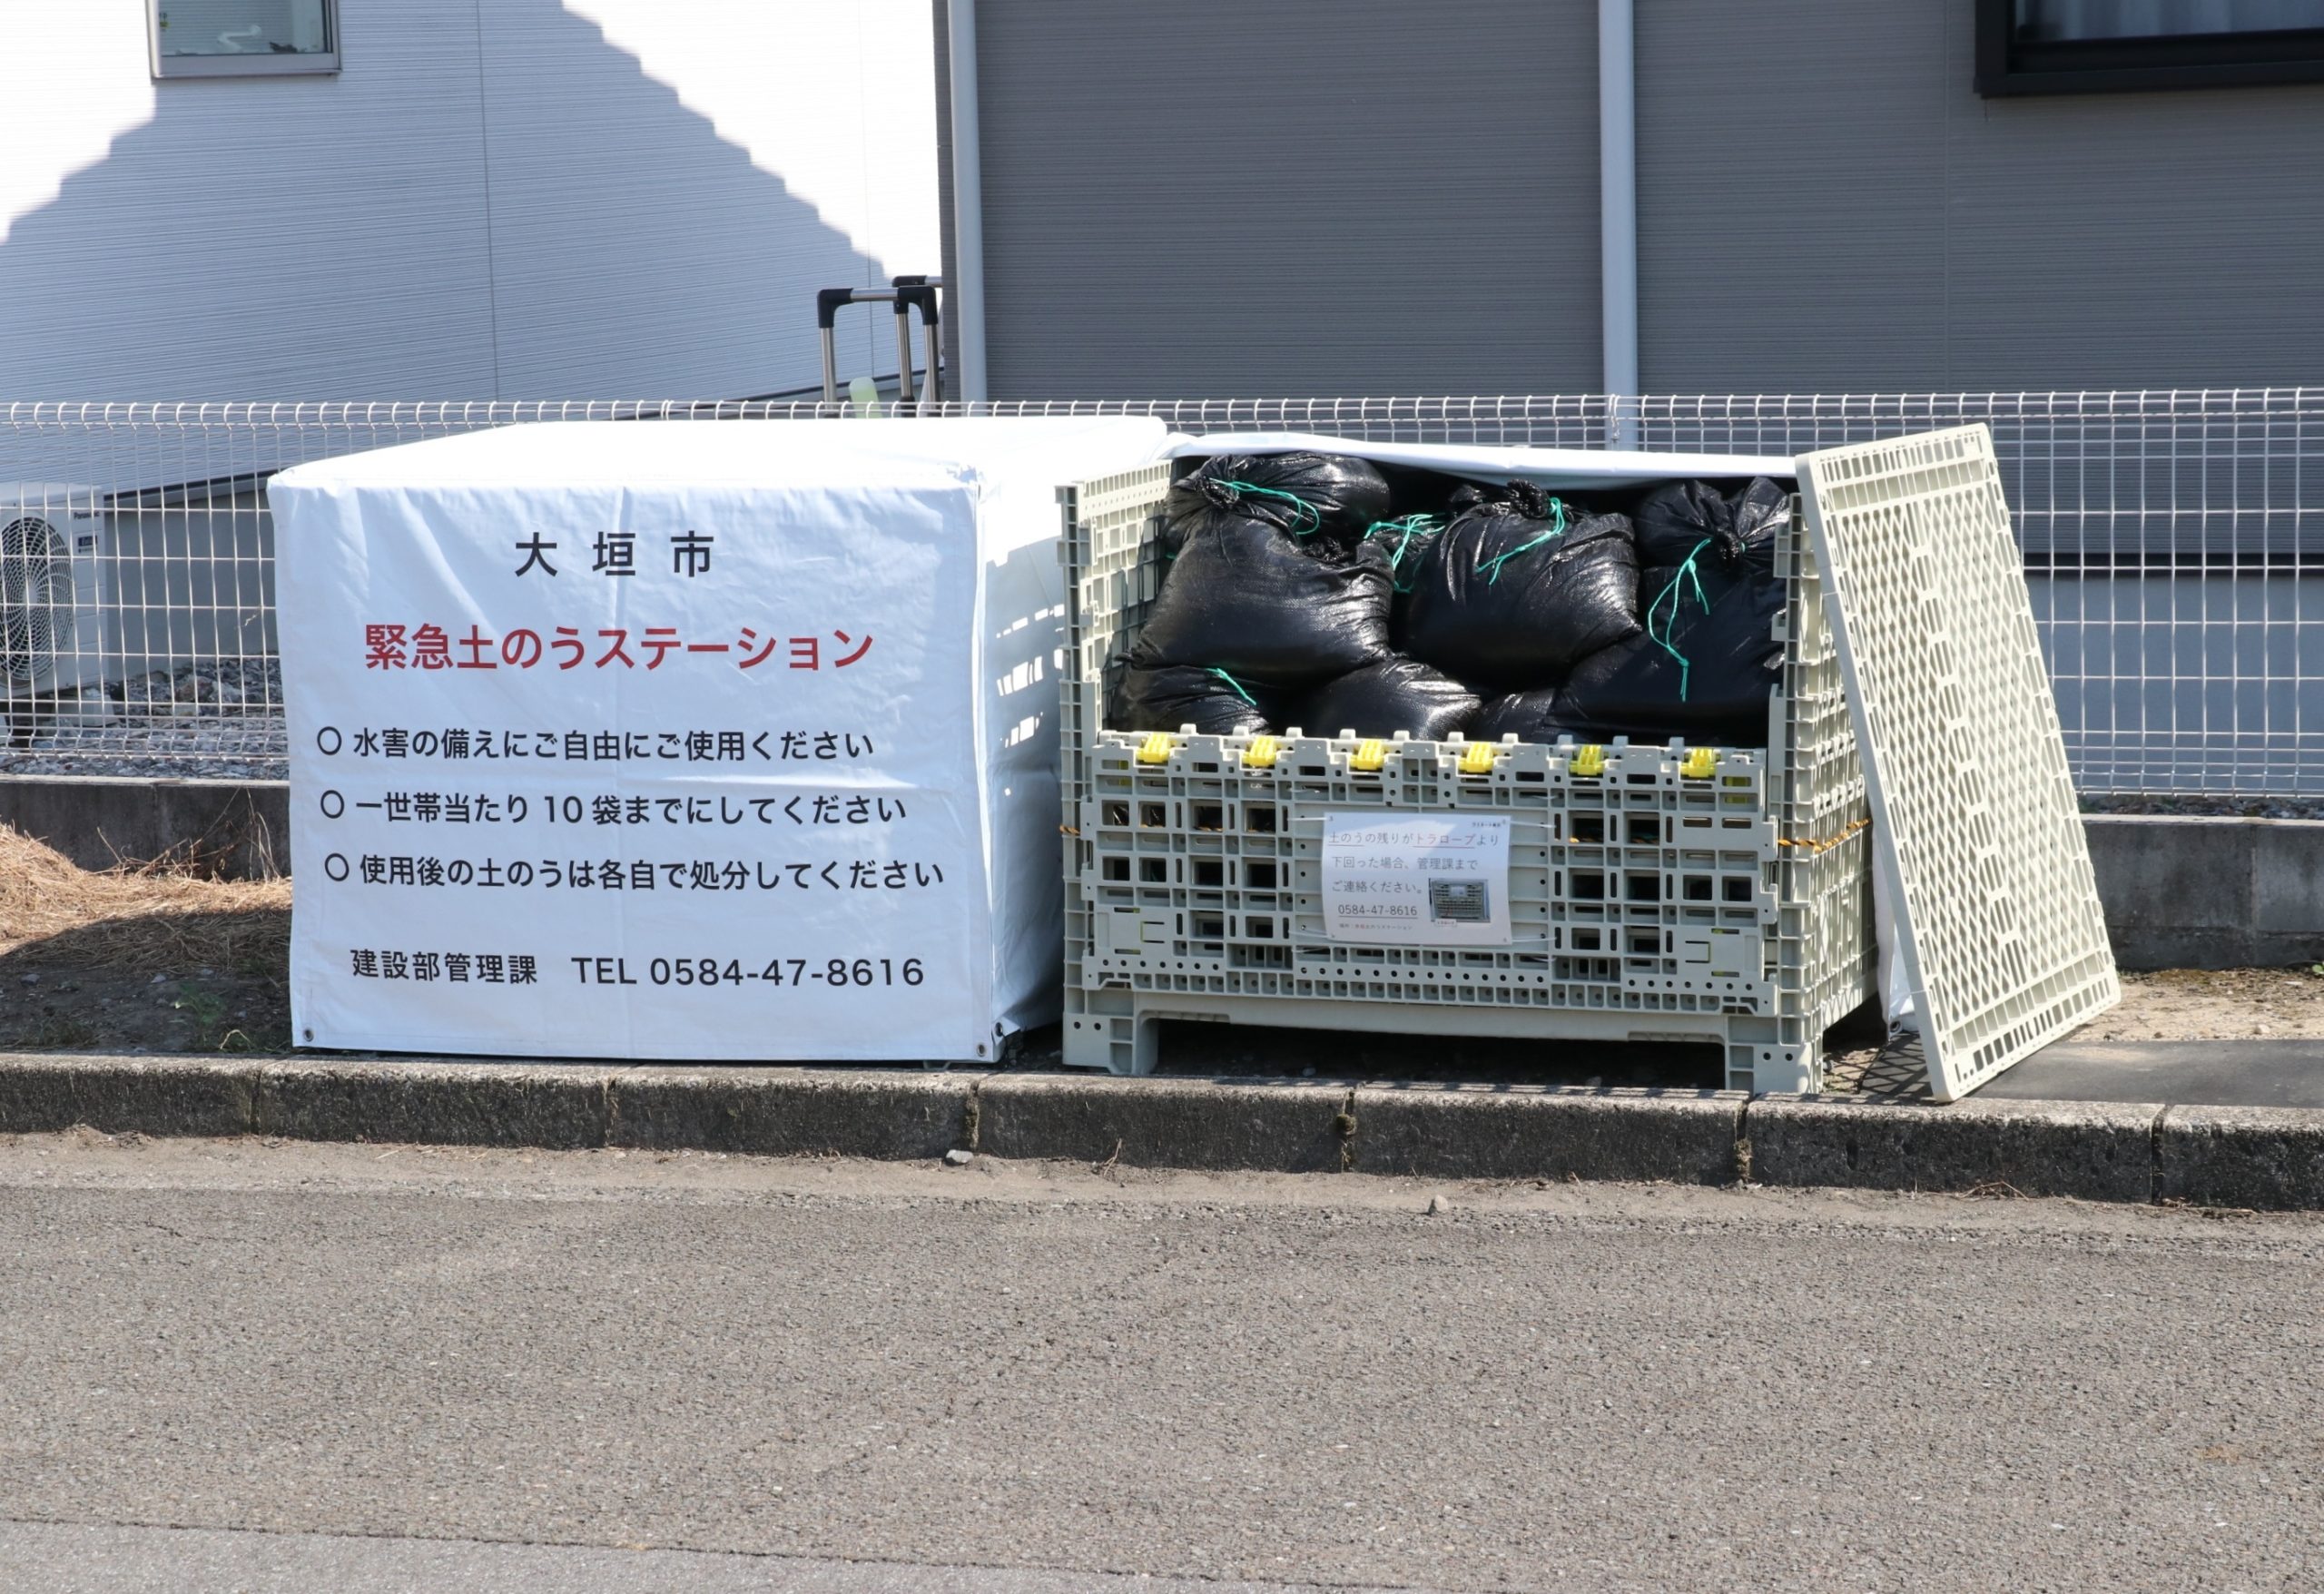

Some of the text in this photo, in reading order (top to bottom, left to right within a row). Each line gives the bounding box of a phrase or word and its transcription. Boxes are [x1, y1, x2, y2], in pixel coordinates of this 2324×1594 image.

[74, 511, 100, 520] Panasic
[514, 530, 714, 578] 大垣市
[365, 624, 874, 671] 緊急土のうステーション
[353, 726, 874, 762] 水害の備えにご自由にご使用ください
[359, 853, 944, 891] 使用後の土のうは各自で処分してください
[1332, 881, 1423, 894] ご連絡ください。
[1338, 904, 1418, 916] 0584-47-8616
[350, 949, 925, 987] 建設部管理課 TEL 0584-47-8616
